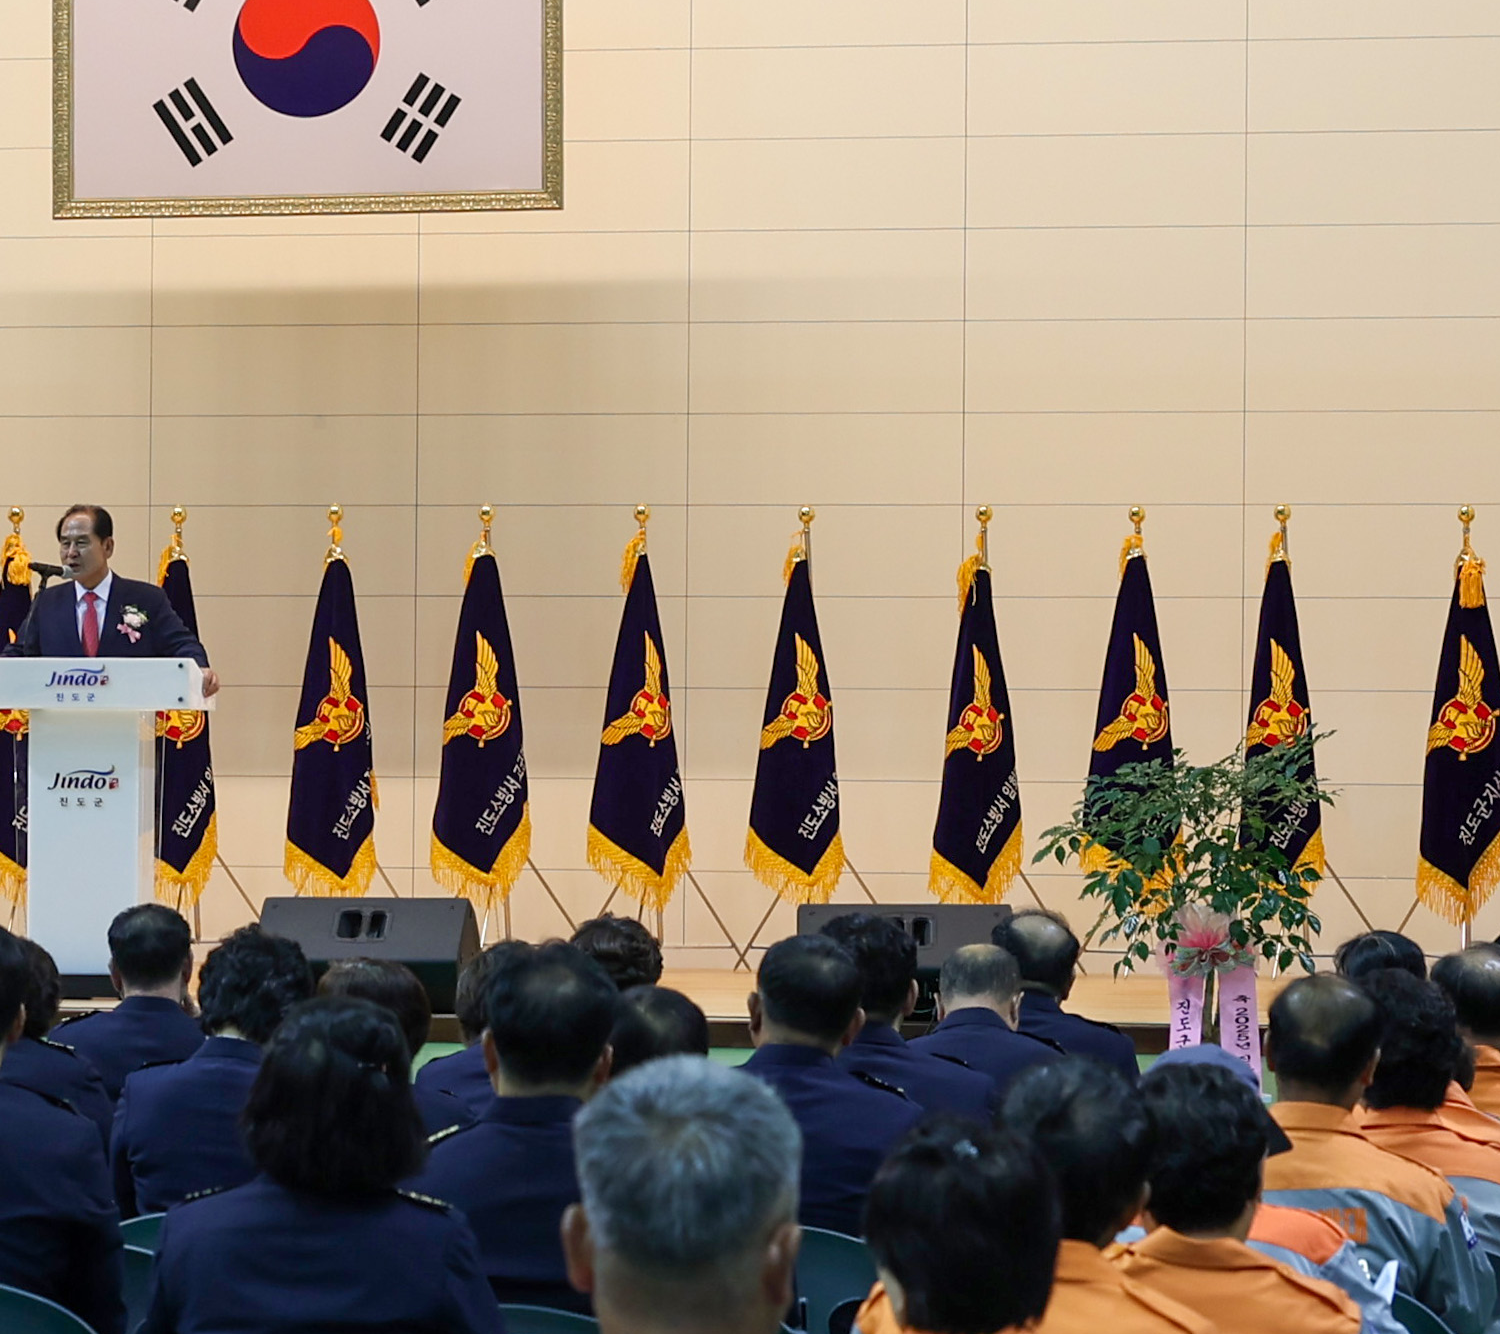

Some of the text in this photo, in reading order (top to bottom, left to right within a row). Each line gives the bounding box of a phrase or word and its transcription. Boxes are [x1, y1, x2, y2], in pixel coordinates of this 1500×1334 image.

[45, 671, 99, 687] Jindo
[47, 772, 107, 791] Jindo
[332, 779, 371, 840] 진도소방서
[475, 774, 522, 836] 진도소방서
[798, 780, 838, 841] 진도소방서
[975, 794, 1010, 854] 진도소방서
